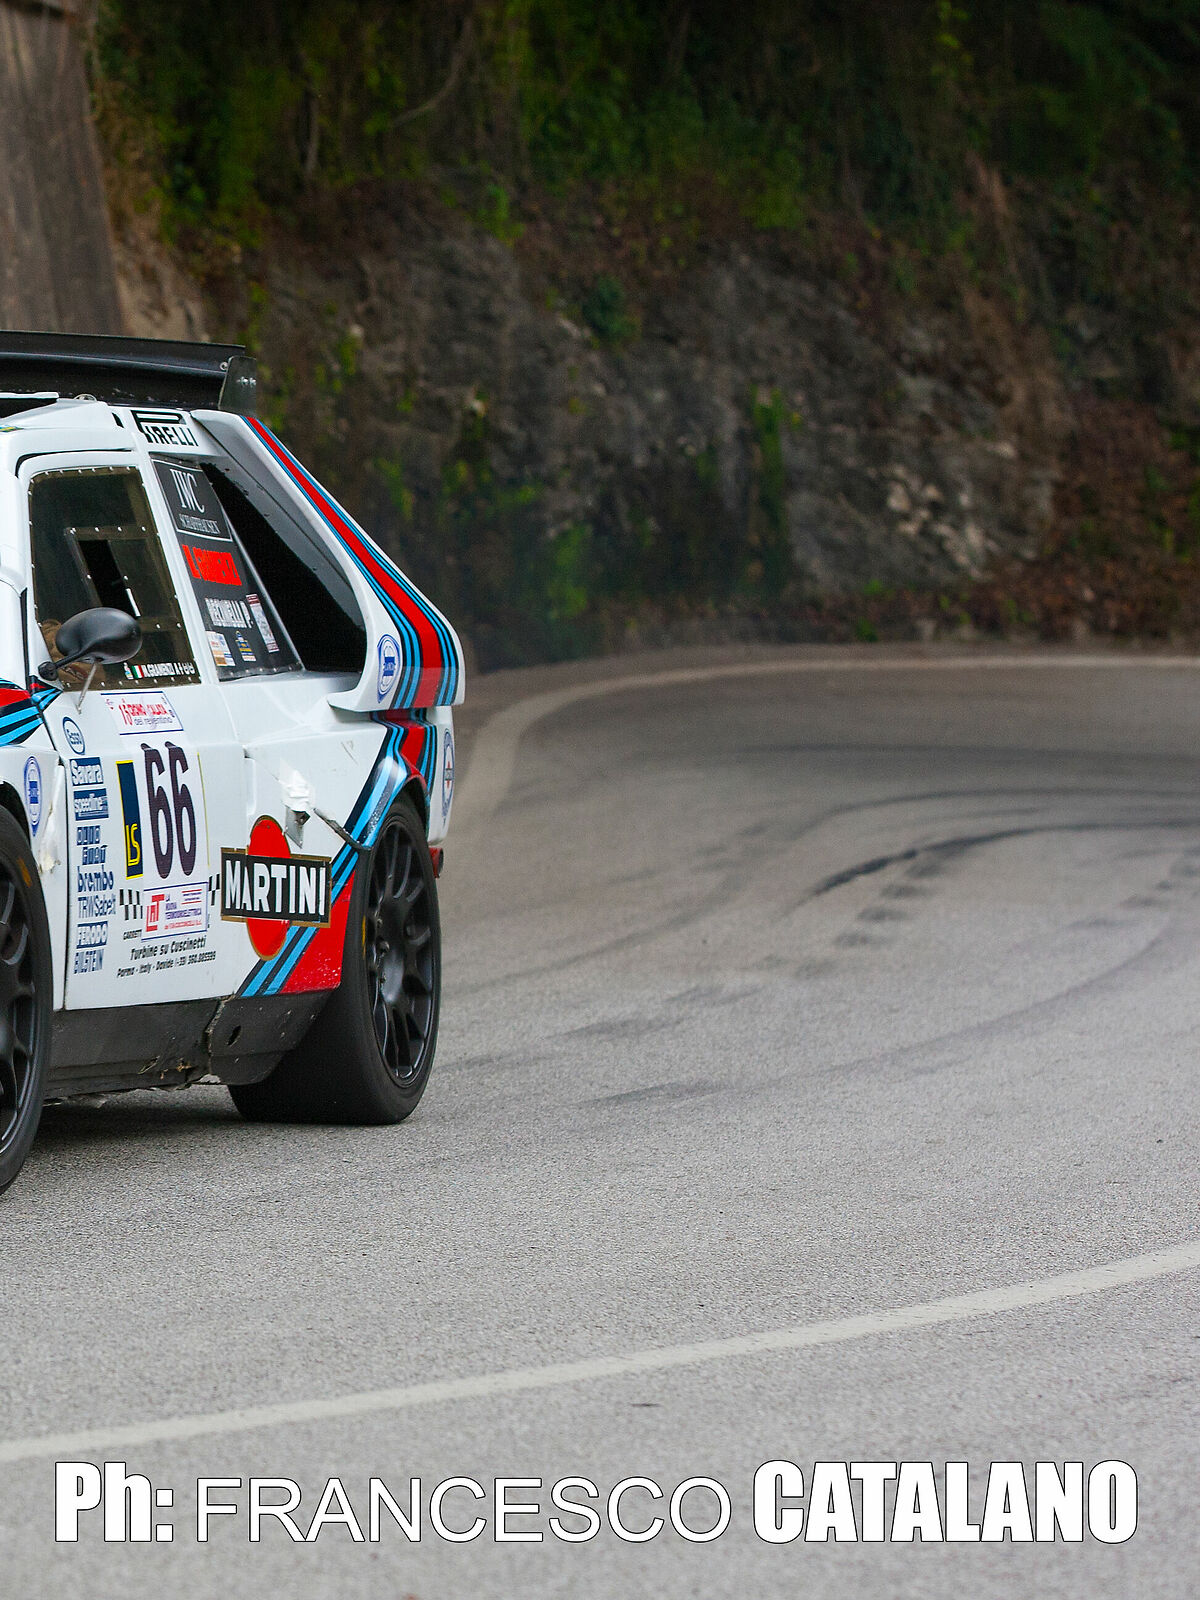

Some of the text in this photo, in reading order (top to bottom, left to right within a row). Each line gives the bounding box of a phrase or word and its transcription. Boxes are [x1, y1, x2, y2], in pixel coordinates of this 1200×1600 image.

[131, 410, 199, 447] PIRELLI
[141, 741, 197, 878] 66
[125, 823, 141, 867] LS
[77, 864, 114, 893] brembo
[225, 860, 326, 916] MARTINI
[130, 934, 207, 961] Turbine su Cuscinetti
